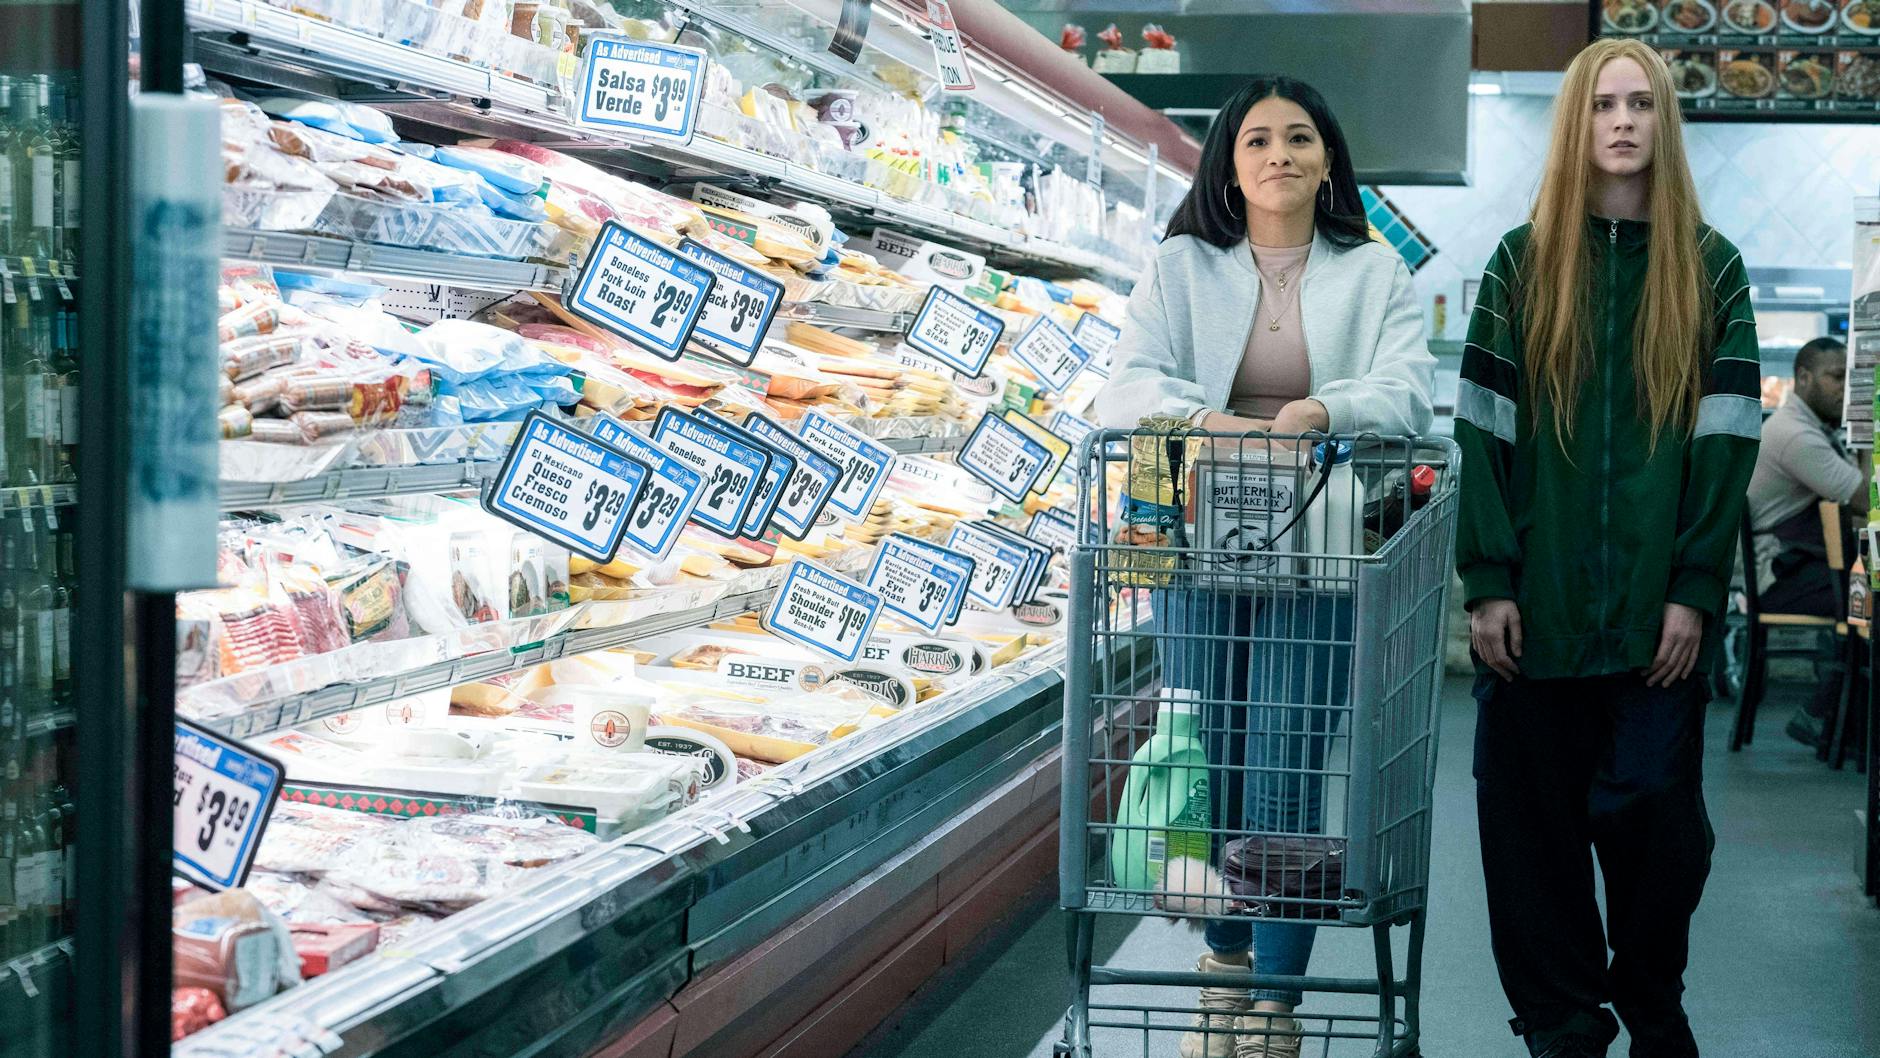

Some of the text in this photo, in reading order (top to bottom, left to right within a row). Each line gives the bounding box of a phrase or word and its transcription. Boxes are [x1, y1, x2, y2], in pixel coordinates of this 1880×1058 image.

[596, 42, 662, 65] As Advertised
[599, 68, 646, 93] Salsa
[596, 90, 643, 115] Verde
[610, 230, 675, 271] As Advertised
[876, 239, 920, 259] BEEF
[610, 256, 652, 283] Boneless
[700, 252, 746, 282] Advertised
[601, 268, 648, 299] Pork Loin
[597, 283, 637, 314] Roast
[708, 293, 728, 309] ack
[925, 328, 949, 346] Steak
[933, 323, 949, 337] Eye
[533, 422, 606, 467] As Advertised
[667, 415, 680, 430] As
[680, 422, 731, 455] Advertised
[756, 420, 767, 434] As
[768, 430, 811, 460] Advertised
[809, 415, 860, 449] As Advertised
[809, 432, 827, 447] Pork
[828, 442, 847, 458] Loin
[600, 423, 666, 471] As Advertised
[668, 441, 707, 467] Boneless
[532, 449, 584, 479] El Mexicano
[532, 462, 573, 490] Queso
[524, 474, 569, 505] Fresco
[1215, 486, 1284, 501] BUTERMLK
[511, 485, 569, 521] Cremoso
[796, 564, 850, 596] As Advertised
[886, 579, 905, 595] Eye
[790, 591, 835, 619] Shoulder
[794, 583, 840, 609] Fresh Pork Butt
[879, 586, 906, 604] Roast
[788, 604, 827, 630] Shanks
[793, 618, 815, 633] Bone-In
[862, 647, 891, 660] EF
[907, 647, 956, 673] HARRIS
[727, 662, 796, 683] BEEF
[657, 740, 693, 751] EST. 1937
